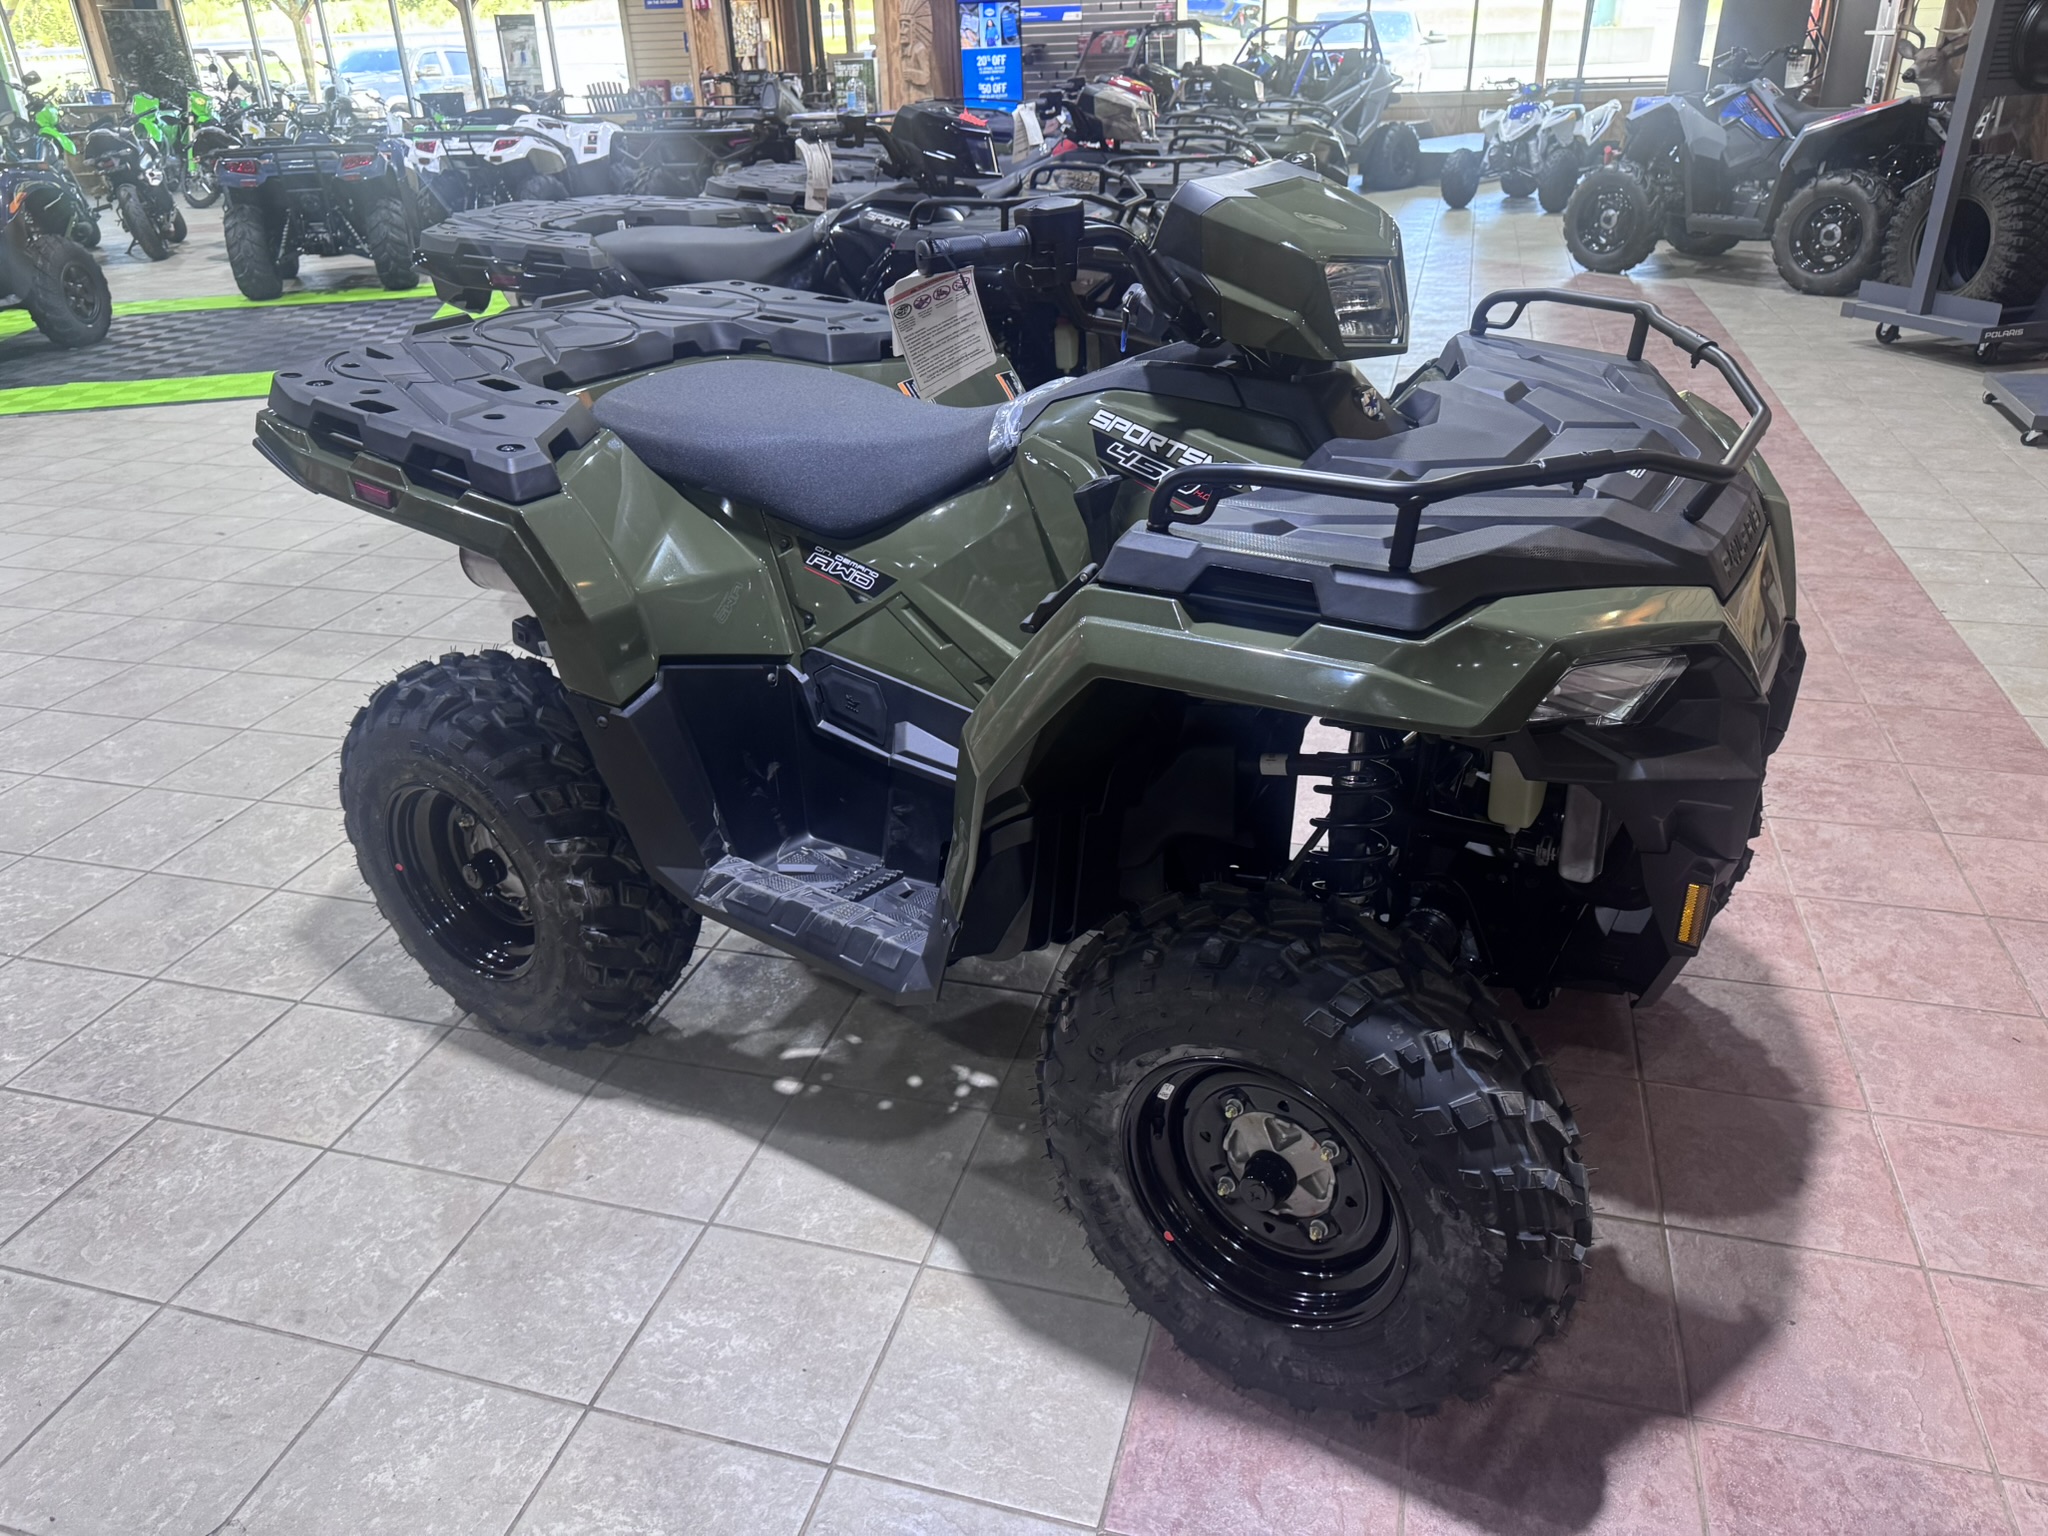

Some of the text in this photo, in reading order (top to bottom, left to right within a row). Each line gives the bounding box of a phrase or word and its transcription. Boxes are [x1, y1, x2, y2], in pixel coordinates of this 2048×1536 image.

[991, 54, 1007, 66] OFF
[992, 82, 1007, 94] OFF
[864, 211, 911, 229] SPORT
[1984, 328, 2024, 339] POLARIS
[806, 552, 875, 590] AWD
